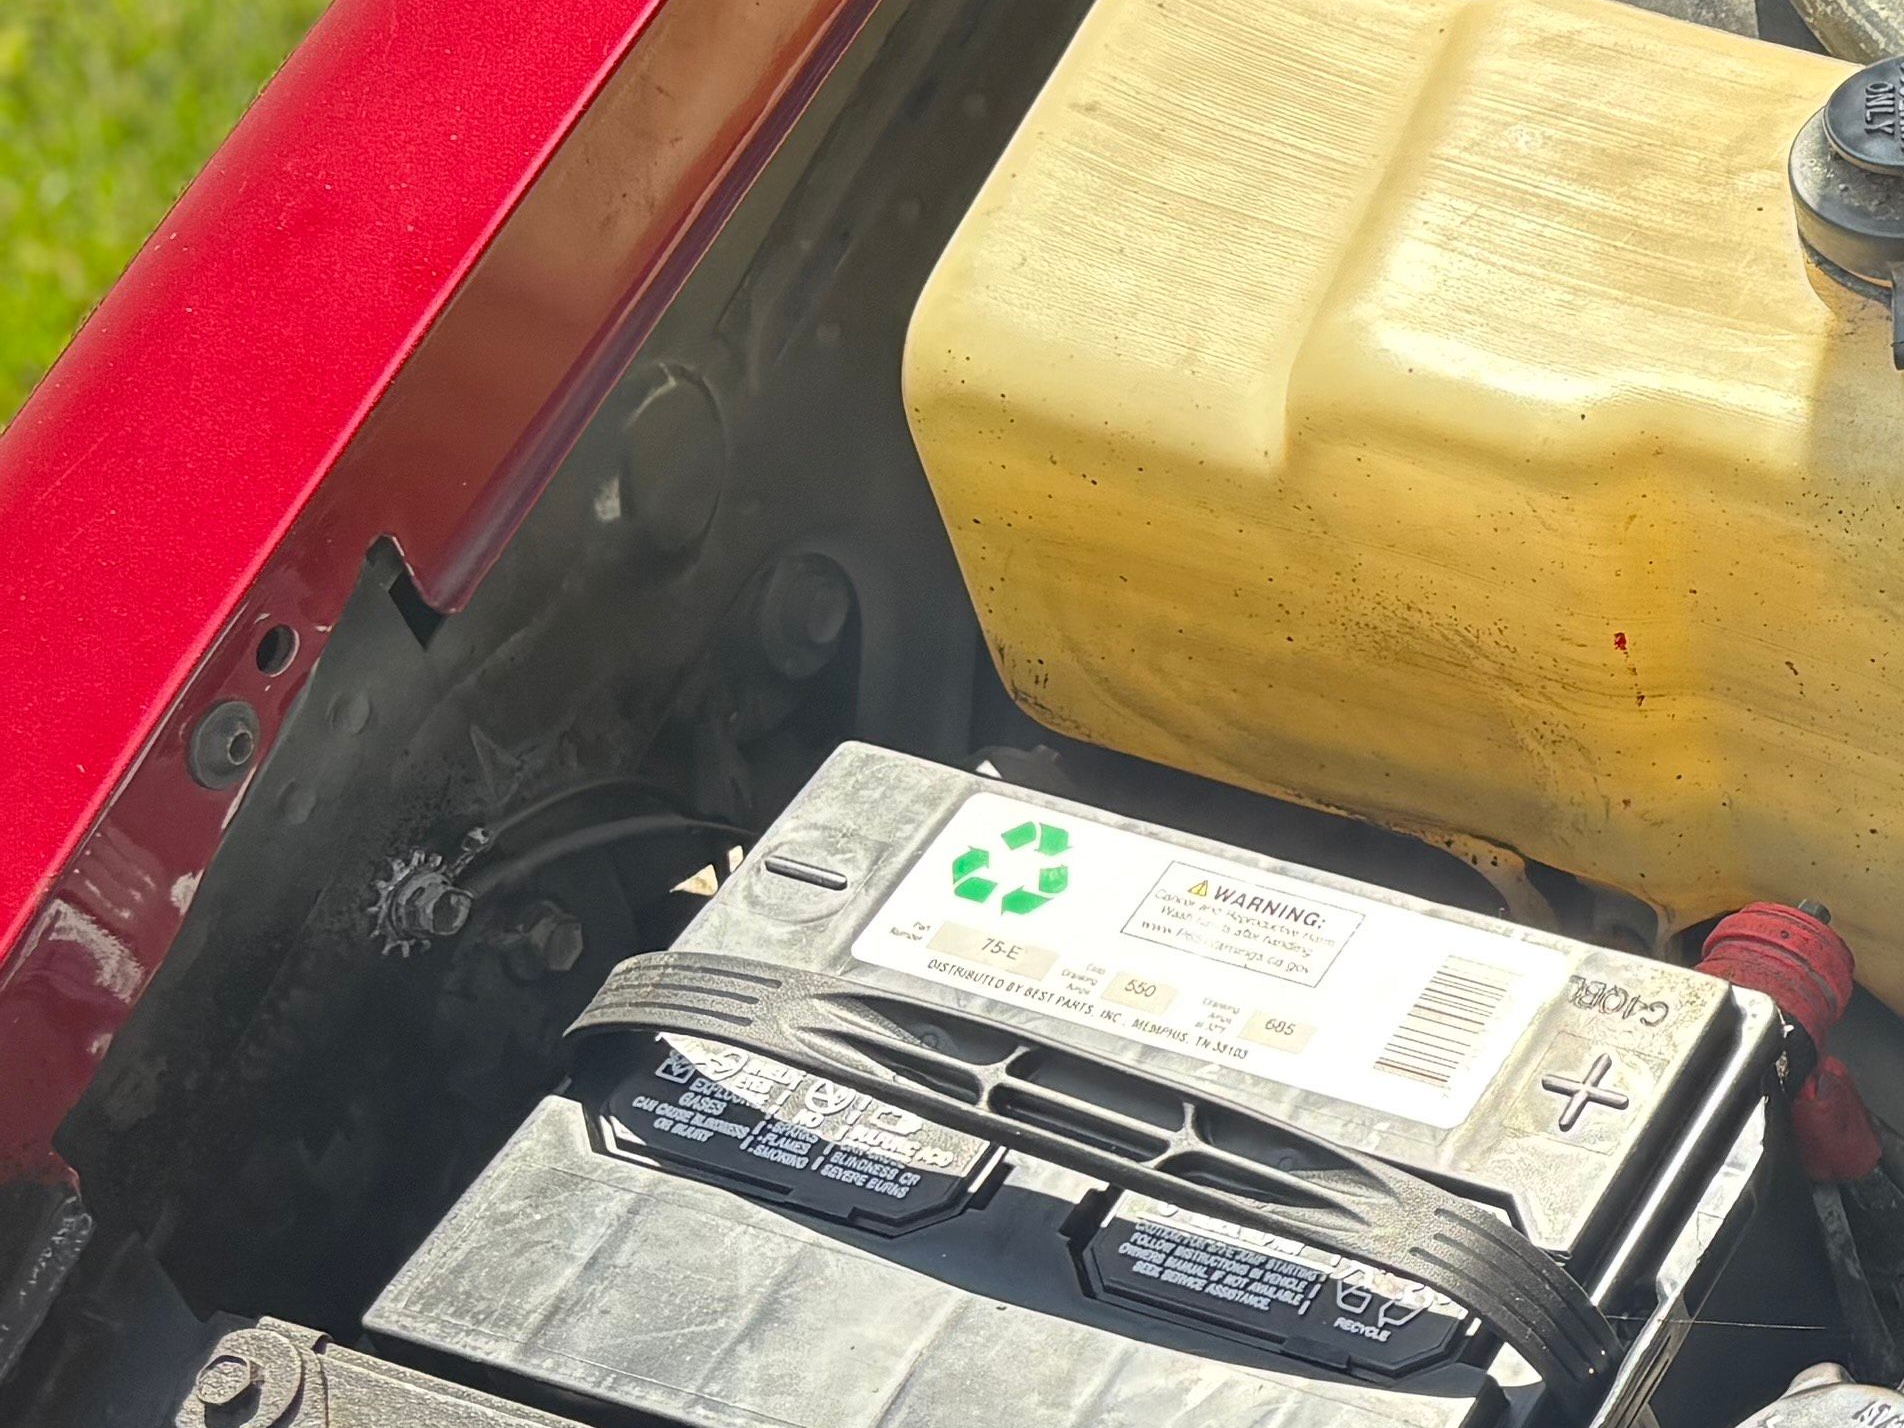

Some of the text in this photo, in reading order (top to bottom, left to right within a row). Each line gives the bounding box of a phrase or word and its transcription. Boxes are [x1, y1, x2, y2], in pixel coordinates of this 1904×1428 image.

[1865, 82, 1895, 136] ONLY
[1212, 882, 1327, 932] WARNING:
[980, 936, 1023, 961] 75-E
[927, 956, 1005, 990] DISTRIBUTED
[1005, 979, 1024, 995] BY
[1023, 984, 1055, 1005] BEST
[1123, 976, 1157, 999] 550
[677, 1090, 727, 1116] GASES
[1129, 1232, 1174, 1254] FOLLOW
[1332, 1316, 1392, 1344] RECYCLE
